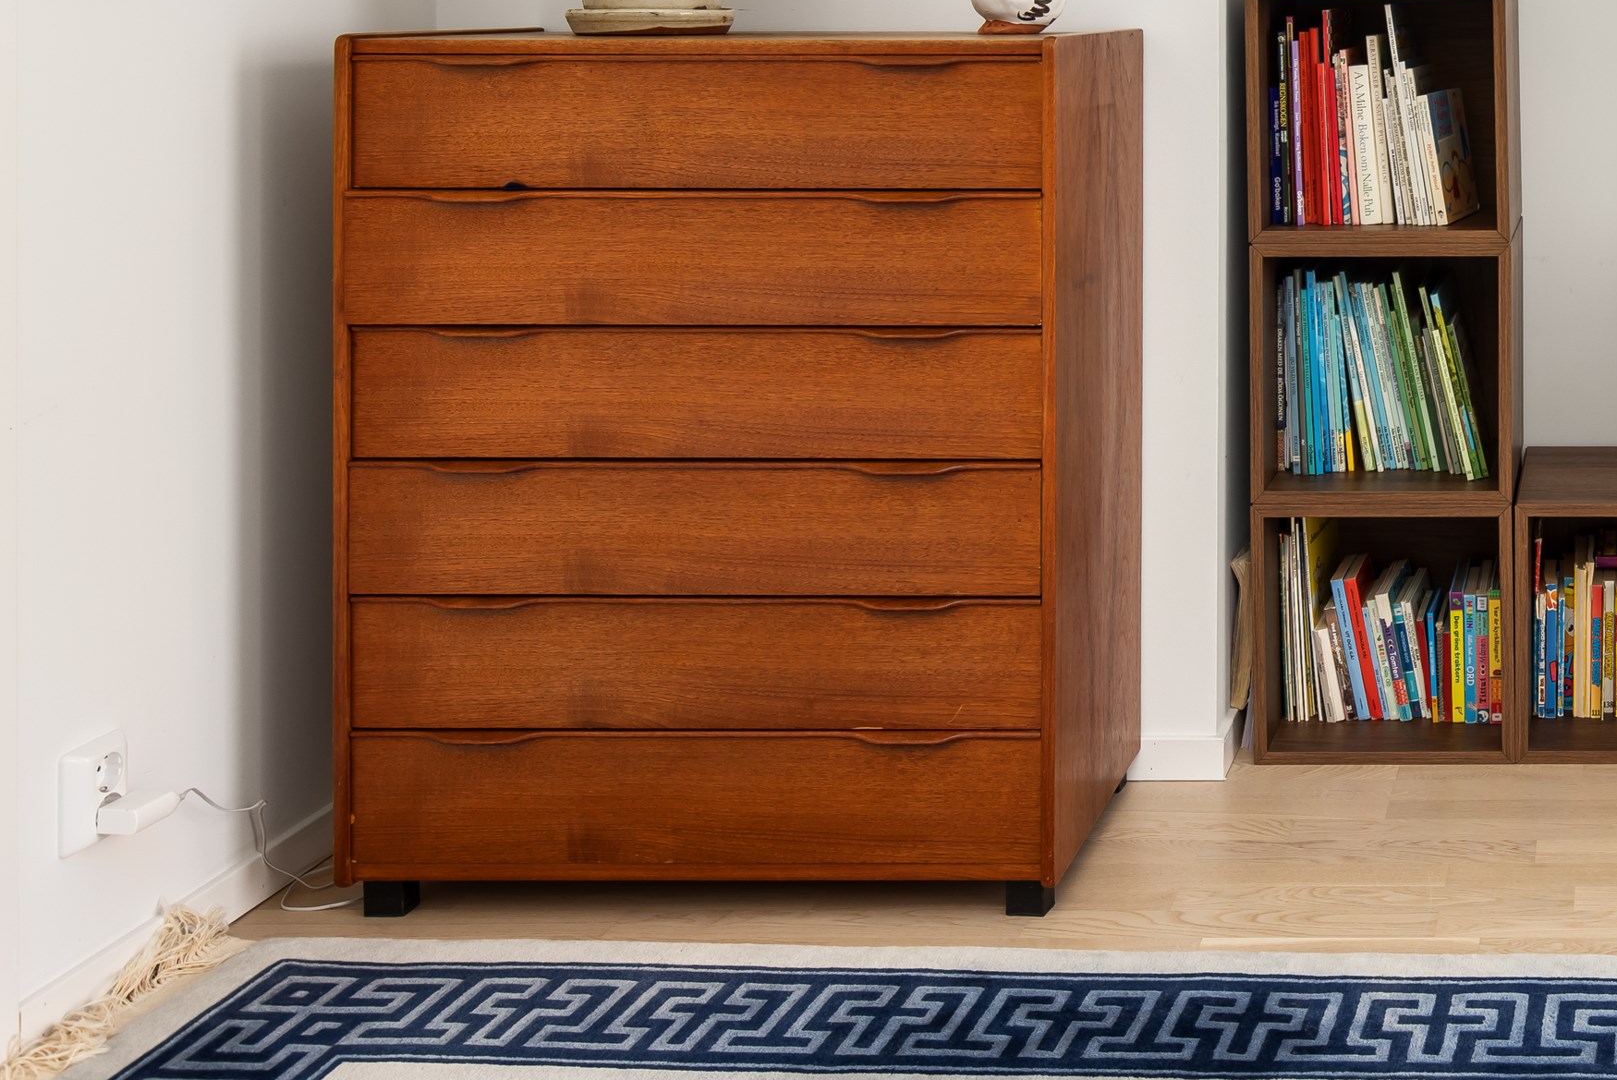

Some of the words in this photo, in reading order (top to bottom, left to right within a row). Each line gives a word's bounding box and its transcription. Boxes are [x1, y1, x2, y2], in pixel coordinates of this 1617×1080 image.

[1354, 72, 1366, 120] A.A.Milne
[1374, 91, 1380, 102] OM
[1358, 124, 1369, 153] Boken
[1361, 156, 1367, 171] om
[1362, 173, 1372, 197] Nalle
[1364, 199, 1374, 216] Puh
[1278, 367, 1283, 375] DE
[1593, 617, 1601, 637] KALLE
[1605, 612, 1613, 631] KALLE
[1593, 638, 1601, 659] ANKAS
[1605, 631, 1613, 654] ANKAS
[1390, 651, 1399, 679] Tomten
[1592, 661, 1601, 687] POCKET
[1605, 654, 1613, 680] POCKET
[1466, 666, 1475, 686] ORD
